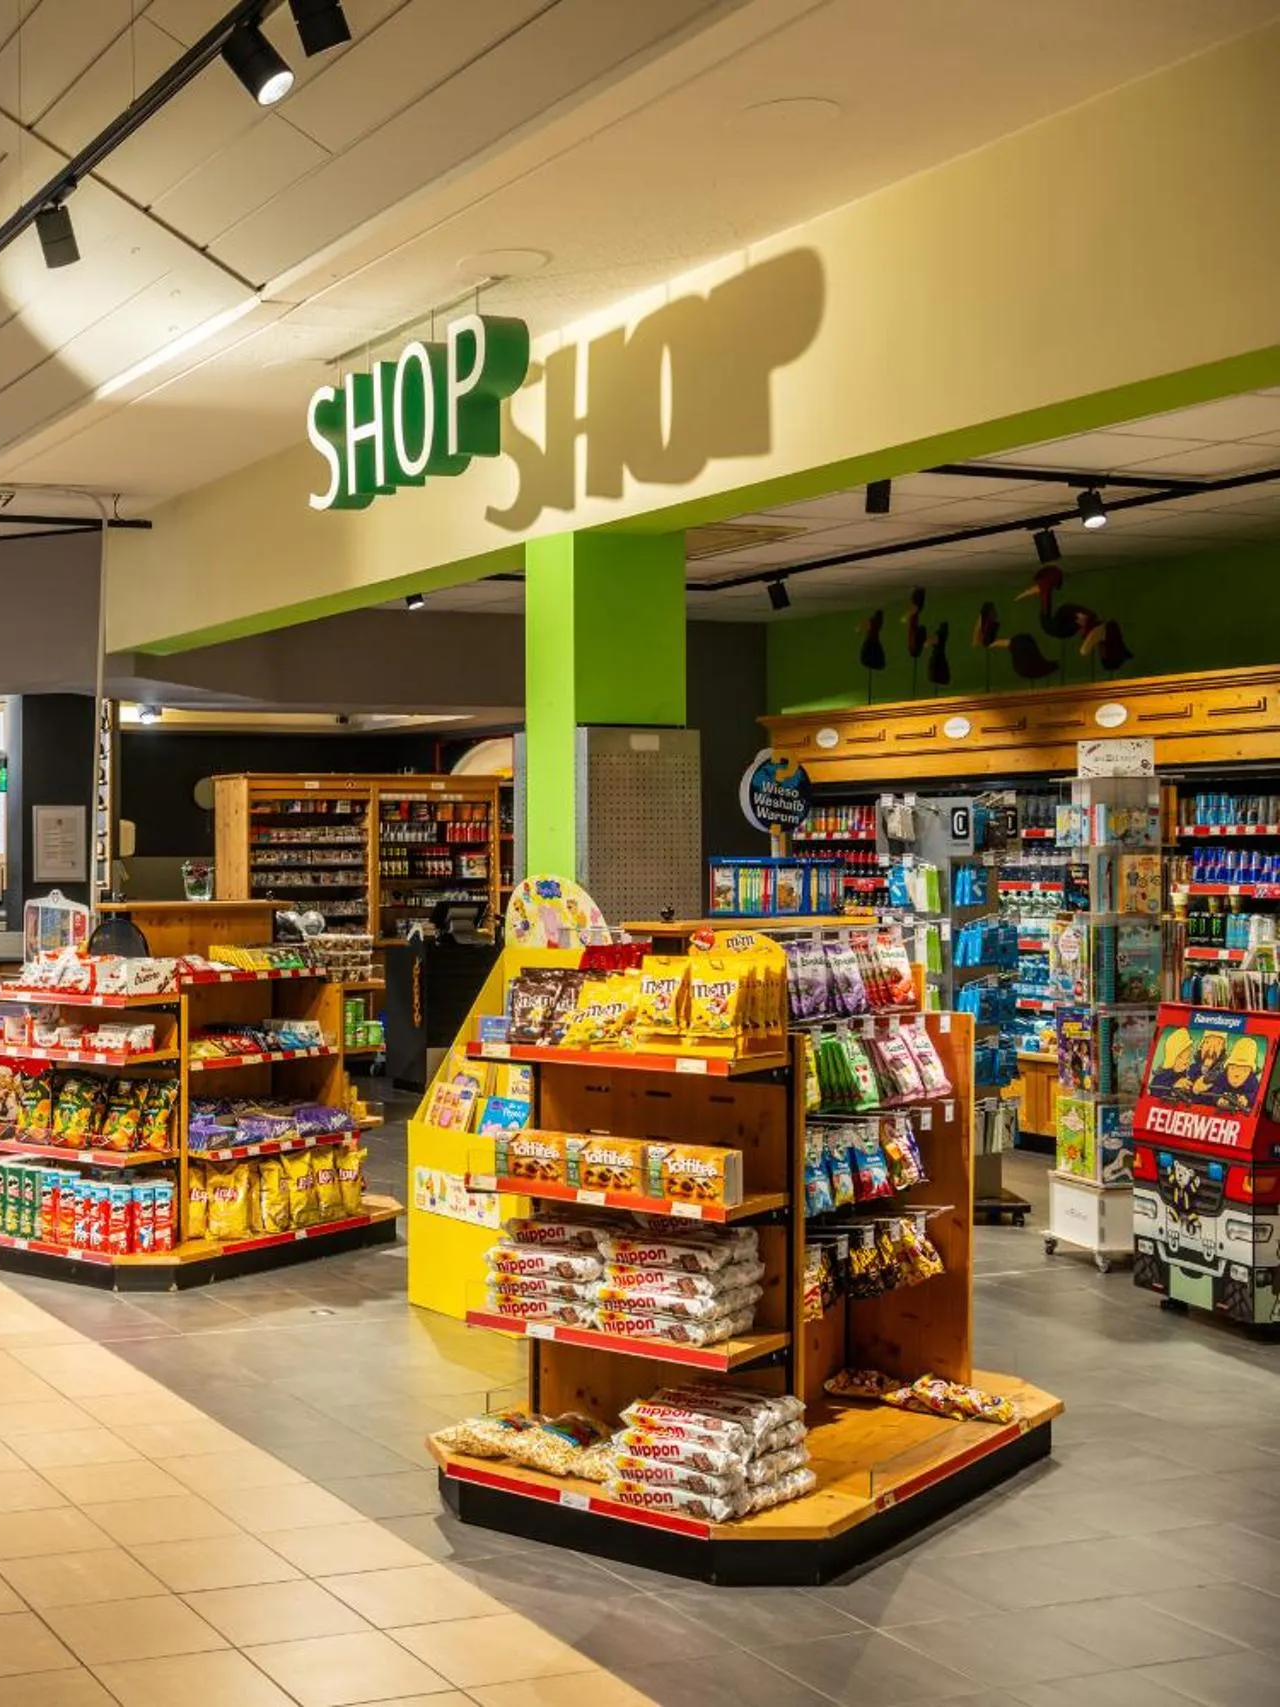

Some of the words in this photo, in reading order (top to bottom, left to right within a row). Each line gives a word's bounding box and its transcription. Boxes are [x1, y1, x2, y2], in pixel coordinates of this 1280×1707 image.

[307, 314, 486, 509] SHOP
[762, 781, 799, 798] Wieso
[753, 792, 805, 812] Weshalb
[756, 806, 800, 824] Warum
[1146, 1106, 1241, 1146] FEUERWEHR
[516, 1224, 566, 1243] nippon
[616, 1247, 667, 1264] nippon
[496, 1257, 545, 1275] nippon
[498, 1279, 547, 1297] nippon
[613, 1271, 664, 1288] nippon
[498, 1300, 548, 1317] nippon
[603, 1295, 656, 1312] nippon
[603, 1317, 656, 1335] nippon
[636, 1406, 694, 1417] nippon
[629, 1444, 680, 1459] nippon
[620, 1468, 674, 1482] nippon
[620, 1492, 673, 1506] nippon
